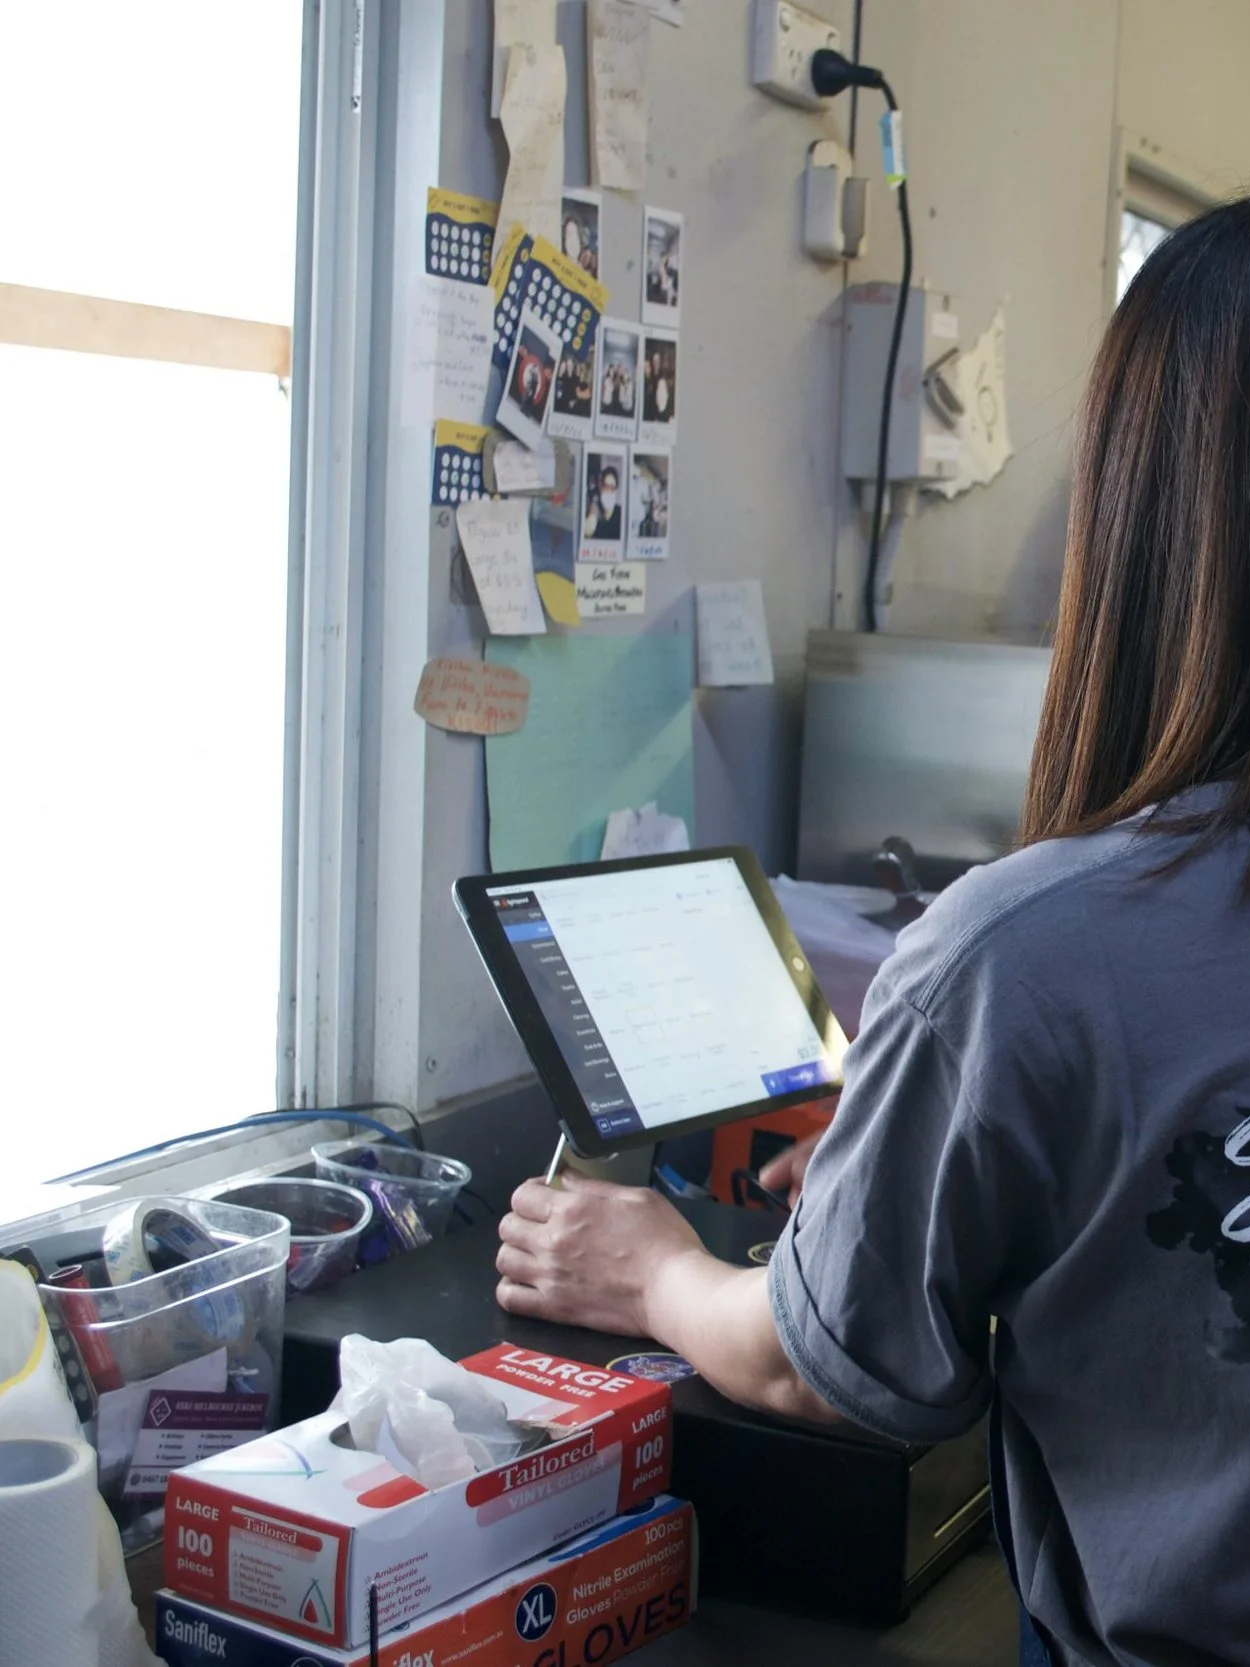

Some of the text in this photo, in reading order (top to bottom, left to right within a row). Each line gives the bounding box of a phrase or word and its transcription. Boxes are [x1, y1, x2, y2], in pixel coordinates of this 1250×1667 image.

[496, 1364, 597, 1399] POWDER FREE
[500, 1350, 634, 1393] LARGE
[632, 1406, 667, 1434] LARGE
[498, 1437, 595, 1492] Tailored
[634, 1436, 664, 1468] 100
[632, 1466, 664, 1490] pieces
[176, 1496, 220, 1521] LARGE
[177, 1525, 214, 1558] 100
[243, 1515, 298, 1545] Tailored
[644, 1523, 667, 1546] 100
[177, 1556, 215, 1579] pieces
[573, 1539, 685, 1601] Nitrile Examination
[377, 1601, 396, 1615] ingle
[522, 1592, 553, 1633] XL
[566, 1598, 612, 1625] Gloves
[612, 1572, 657, 1605] Powder
[165, 1608, 228, 1659] Saniflex
